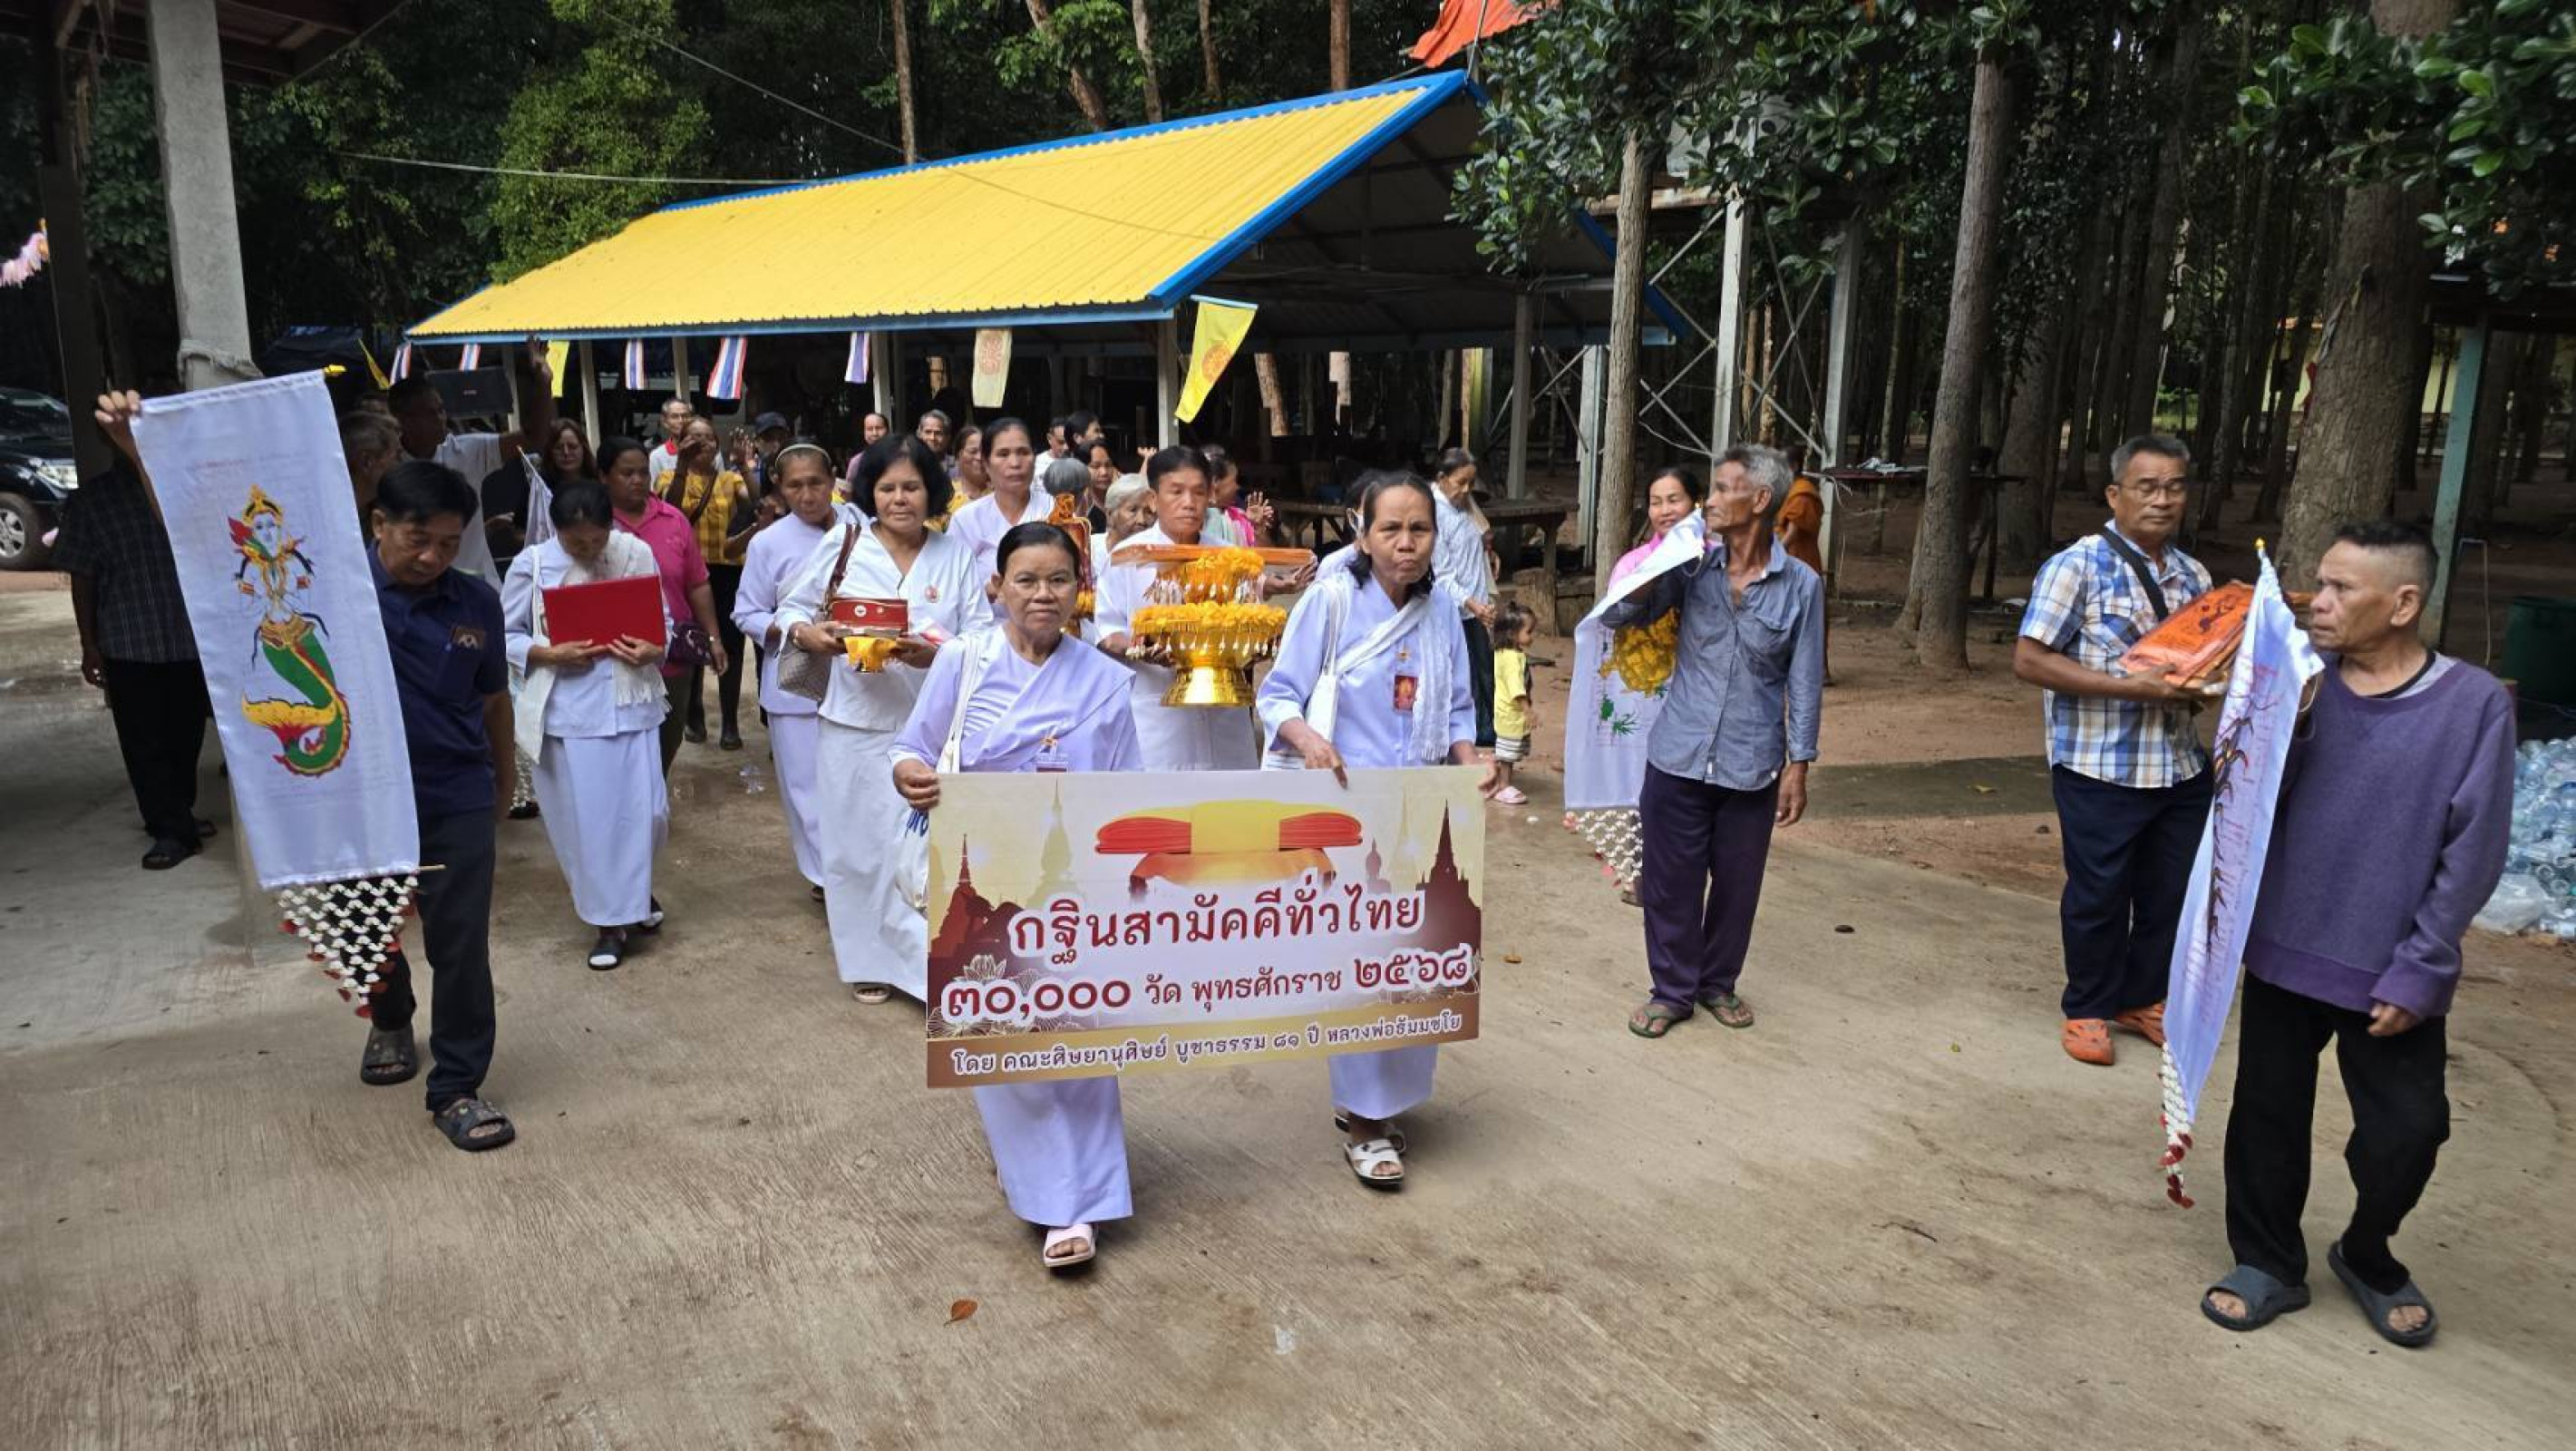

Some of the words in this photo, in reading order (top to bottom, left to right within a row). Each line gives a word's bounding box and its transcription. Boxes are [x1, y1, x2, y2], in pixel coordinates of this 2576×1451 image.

[1014, 873, 1420, 965] กฐินสามัคคีทั่วไทย
[948, 979, 1132, 1019] ๓๐,๐๐๐
[1144, 974, 1181, 1005] วัด
[1191, 967, 1342, 1013] พุทธศักราช
[1354, 949, 1468, 988] ๒๕๖๘
[954, 1051, 994, 1072] โดย
[1004, 1037, 1168, 1068] คณะศิษยานุศิษย์
[1176, 1036, 1266, 1063] บูชาธรรม
[1307, 1025, 1319, 1045] ปี
